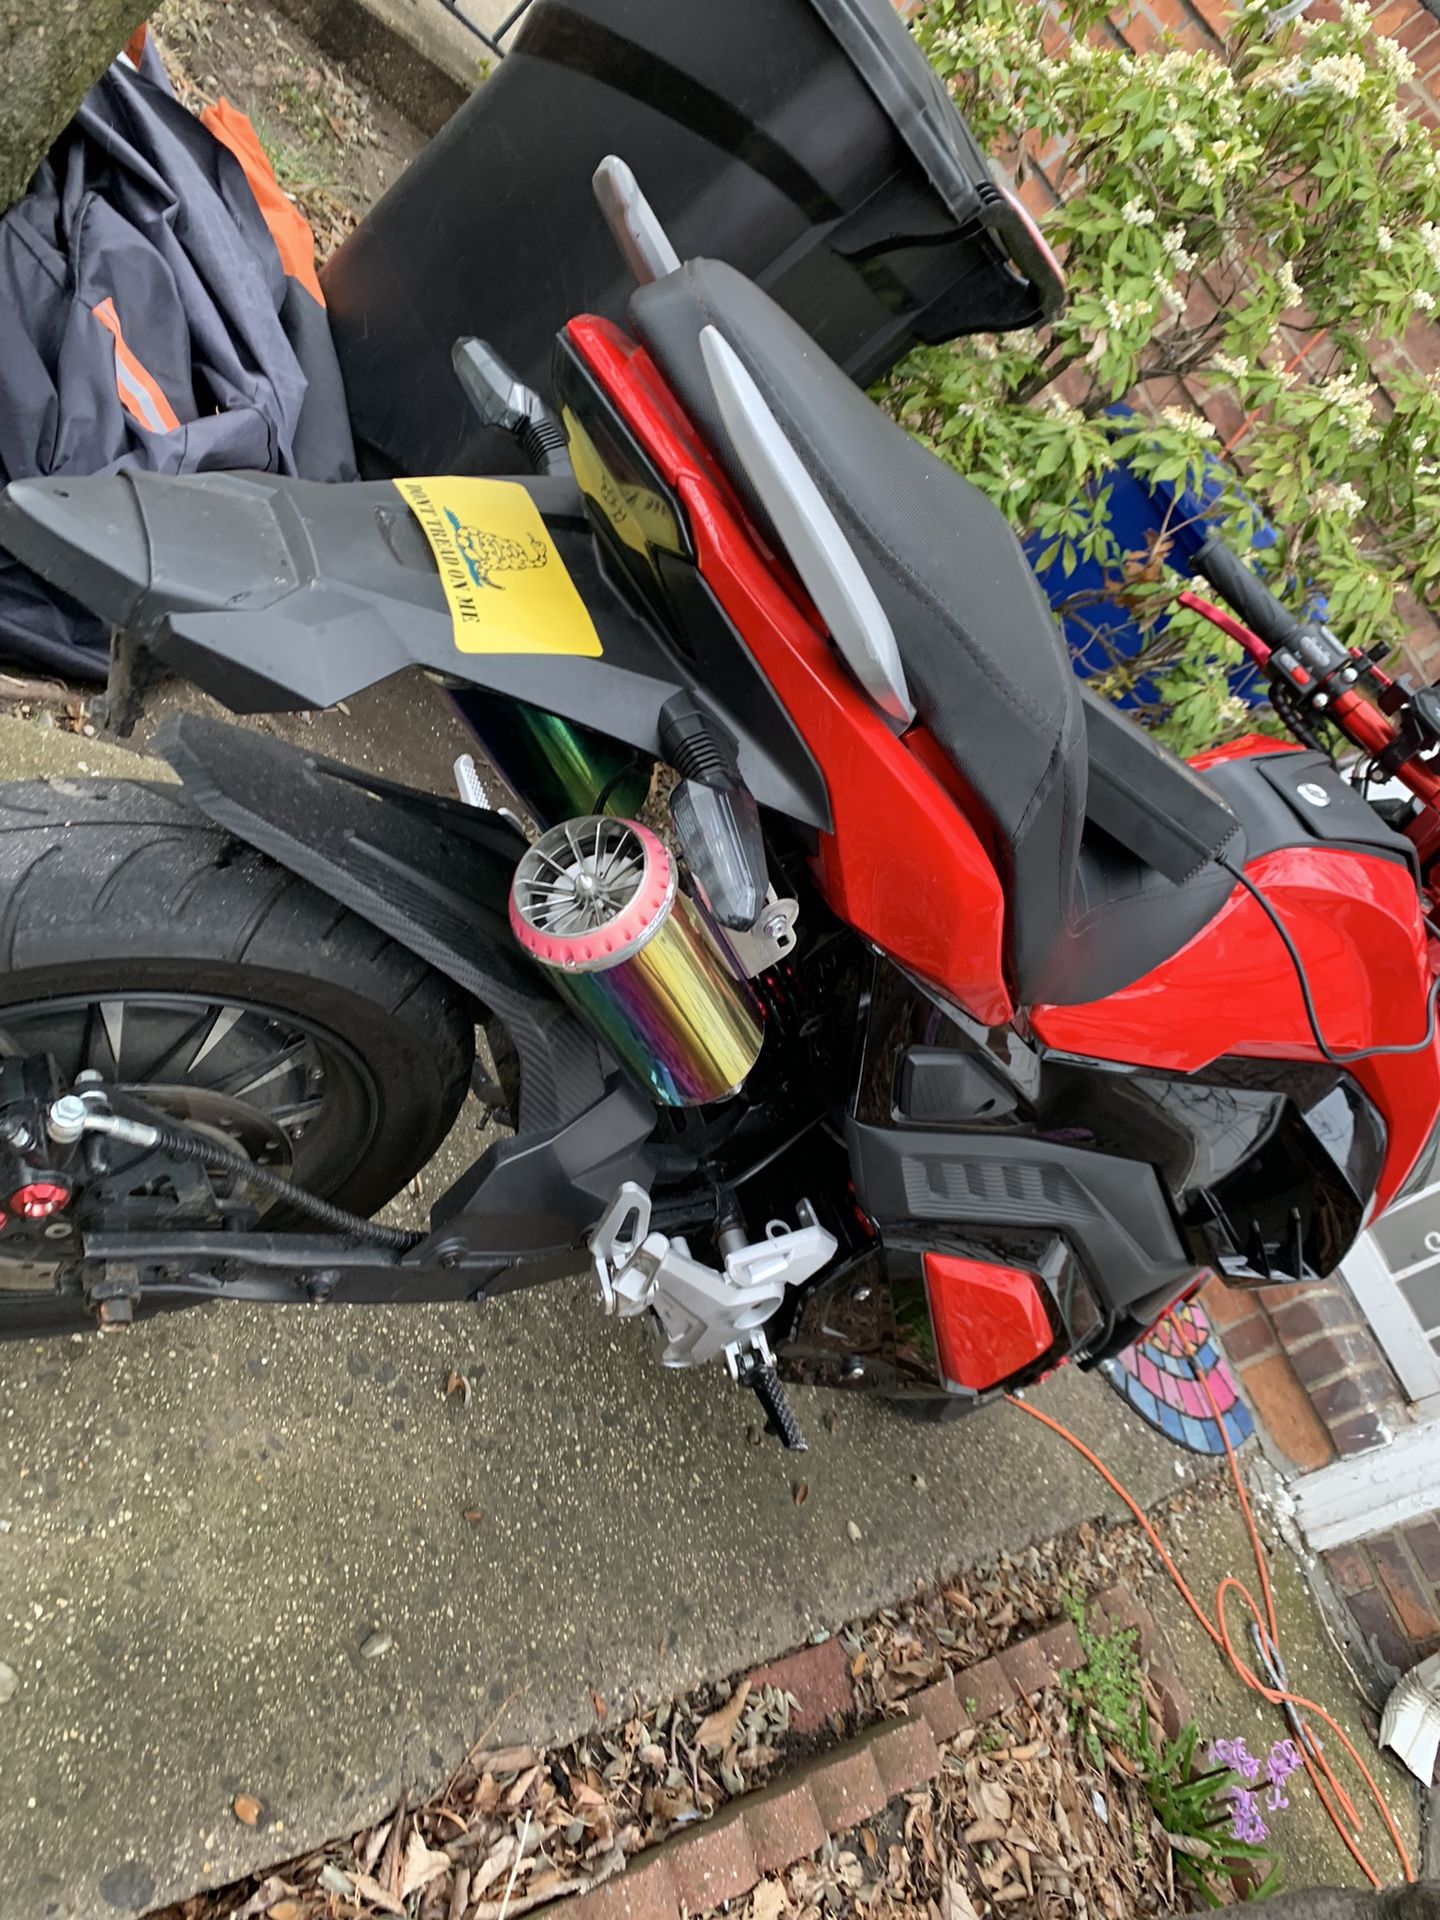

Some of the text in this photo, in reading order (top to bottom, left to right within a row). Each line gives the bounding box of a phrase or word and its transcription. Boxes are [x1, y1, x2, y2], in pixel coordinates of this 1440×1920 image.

[426, 518, 460, 566] TREAD
[447, 568, 471, 592] ON
[455, 595, 481, 623] ME
